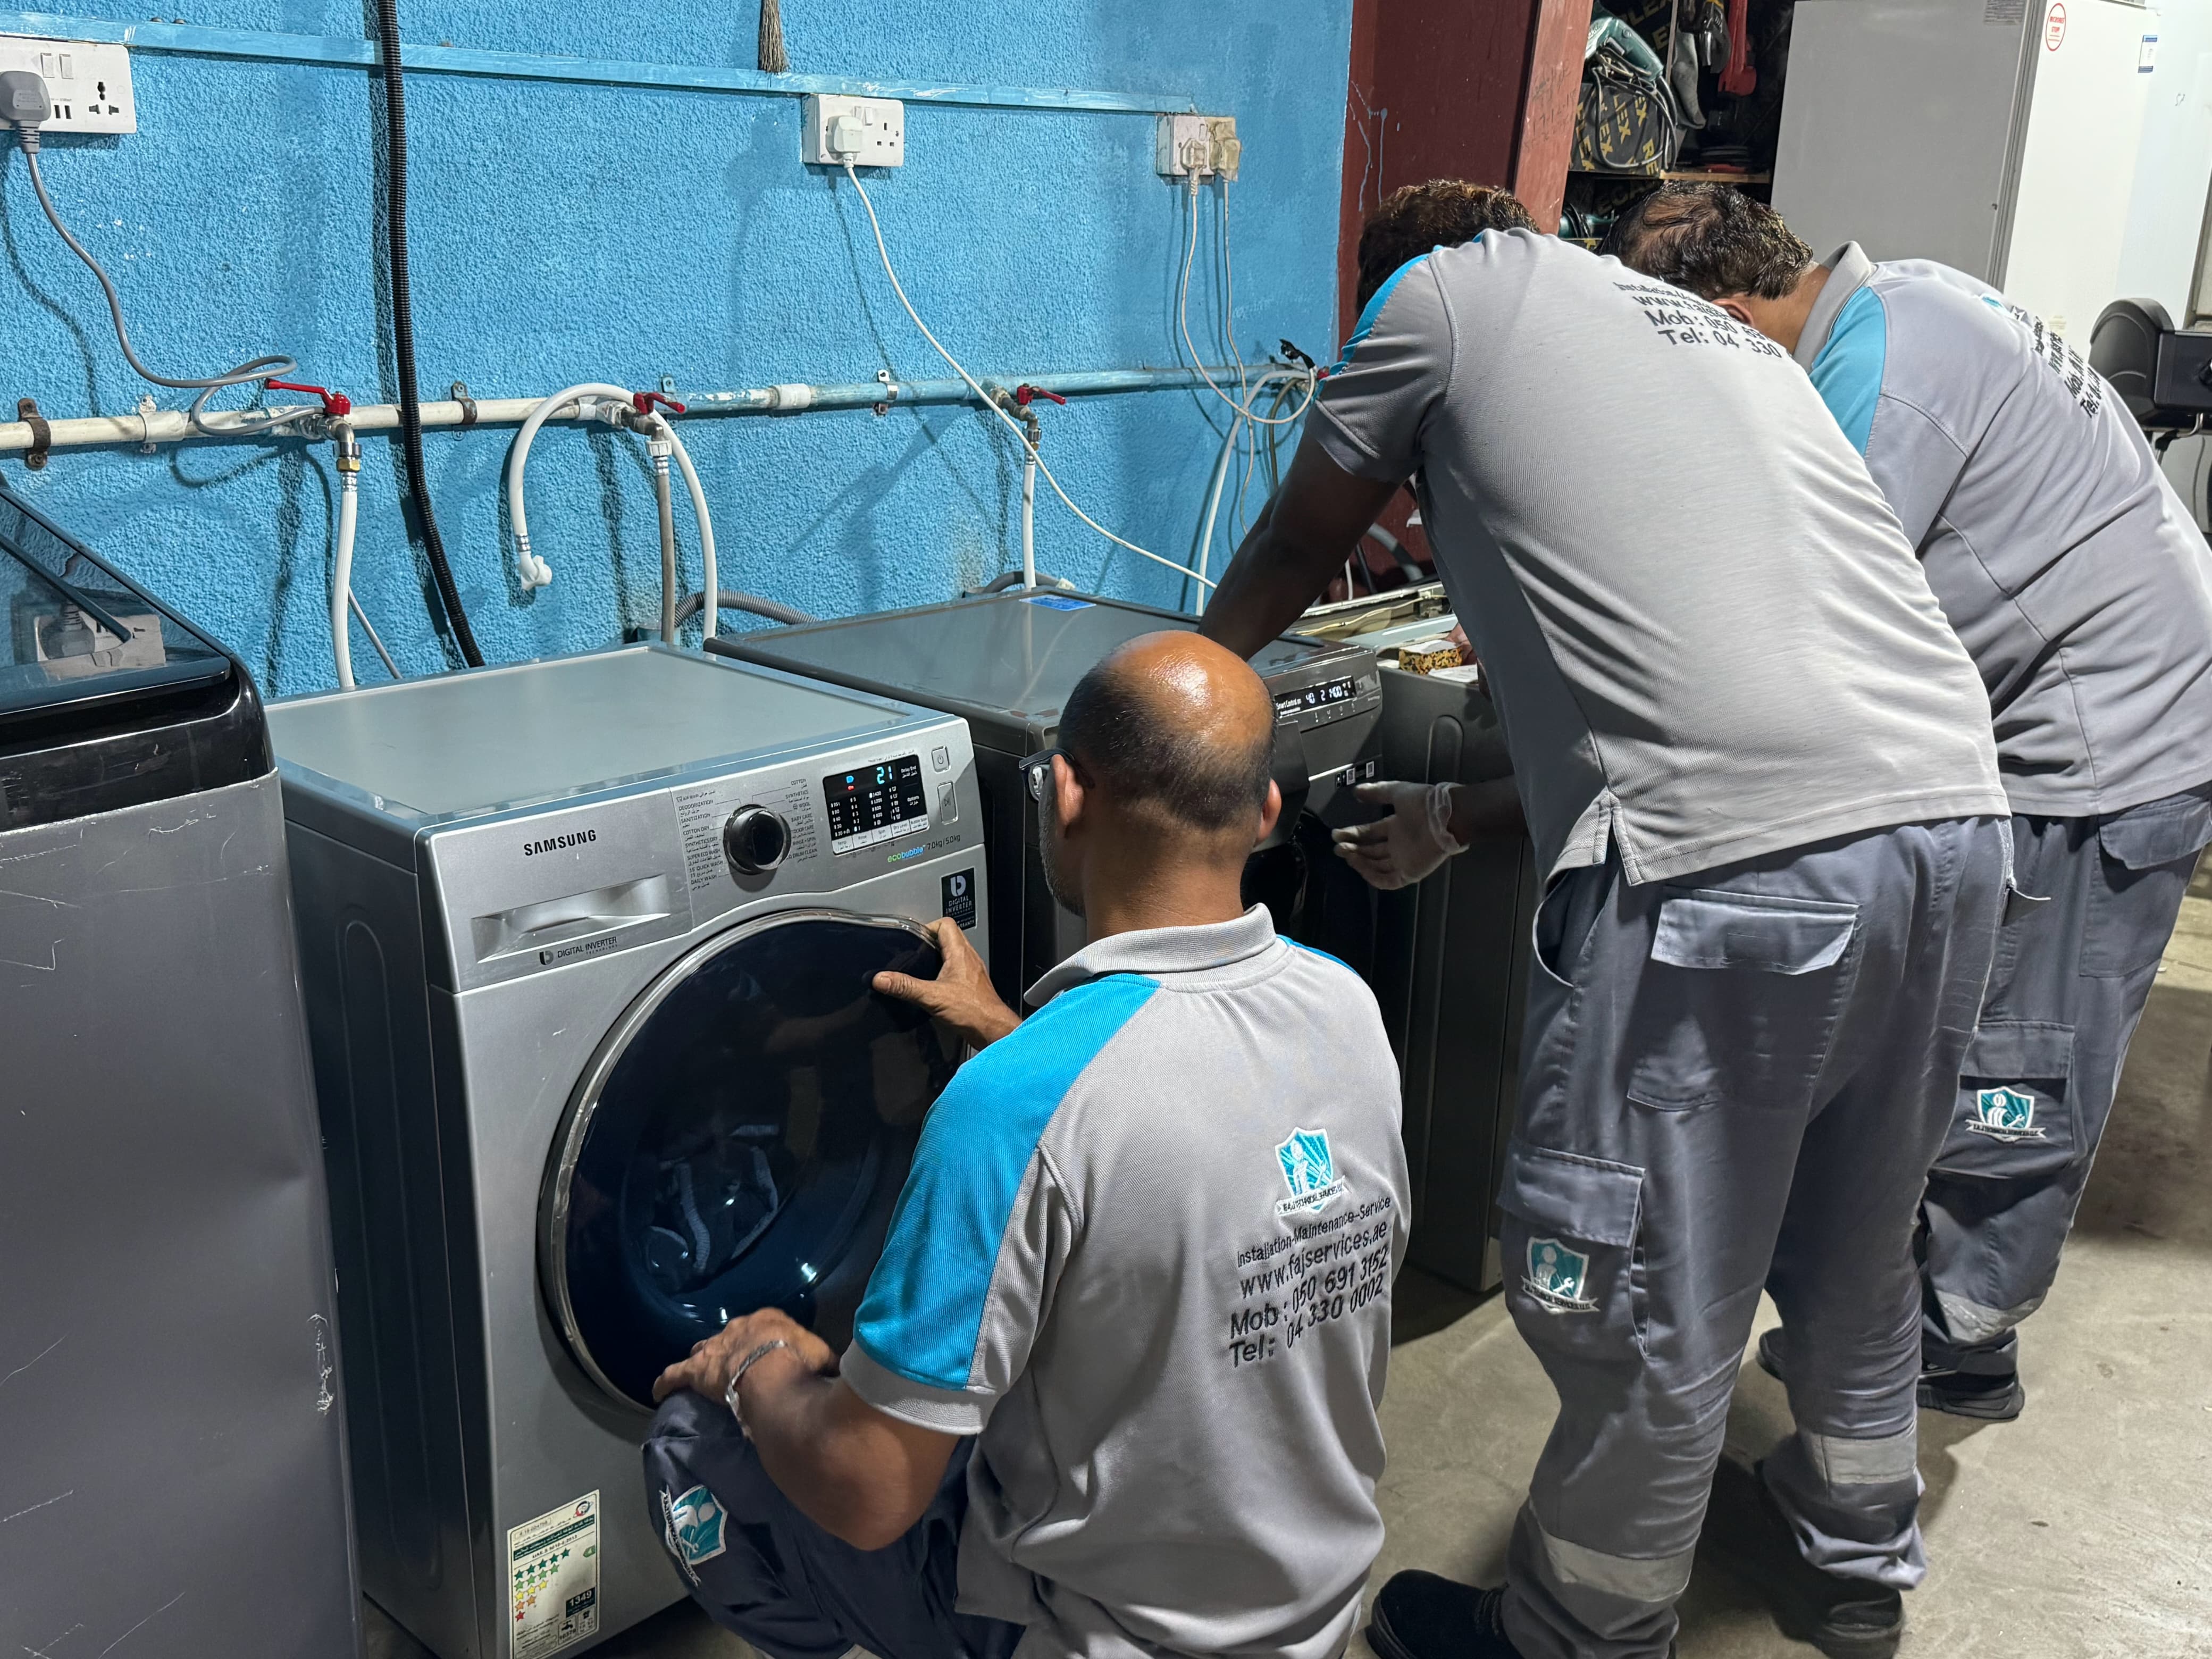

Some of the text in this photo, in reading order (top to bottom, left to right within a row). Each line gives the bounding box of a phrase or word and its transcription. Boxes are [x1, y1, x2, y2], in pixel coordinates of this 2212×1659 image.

[1712, 330, 1739, 349] 04
[1745, 338, 1782, 358] 330
[523, 829, 597, 857] SAMSUNG
[945, 901, 973, 914] INVERTER
[949, 895, 969, 907] DIGITAL
[557, 936, 617, 959] DIGITAL INVERTER
[1240, 1220, 1388, 1299] www.fajservices.ae
[1292, 1278, 1317, 1314] 050
[1325, 1266, 1355, 1294] 691
[1359, 1245, 1388, 1282] 3152
[1228, 1273, 1384, 1368] Tel: 04 330 0002
[569, 1590, 592, 1606] 1349
